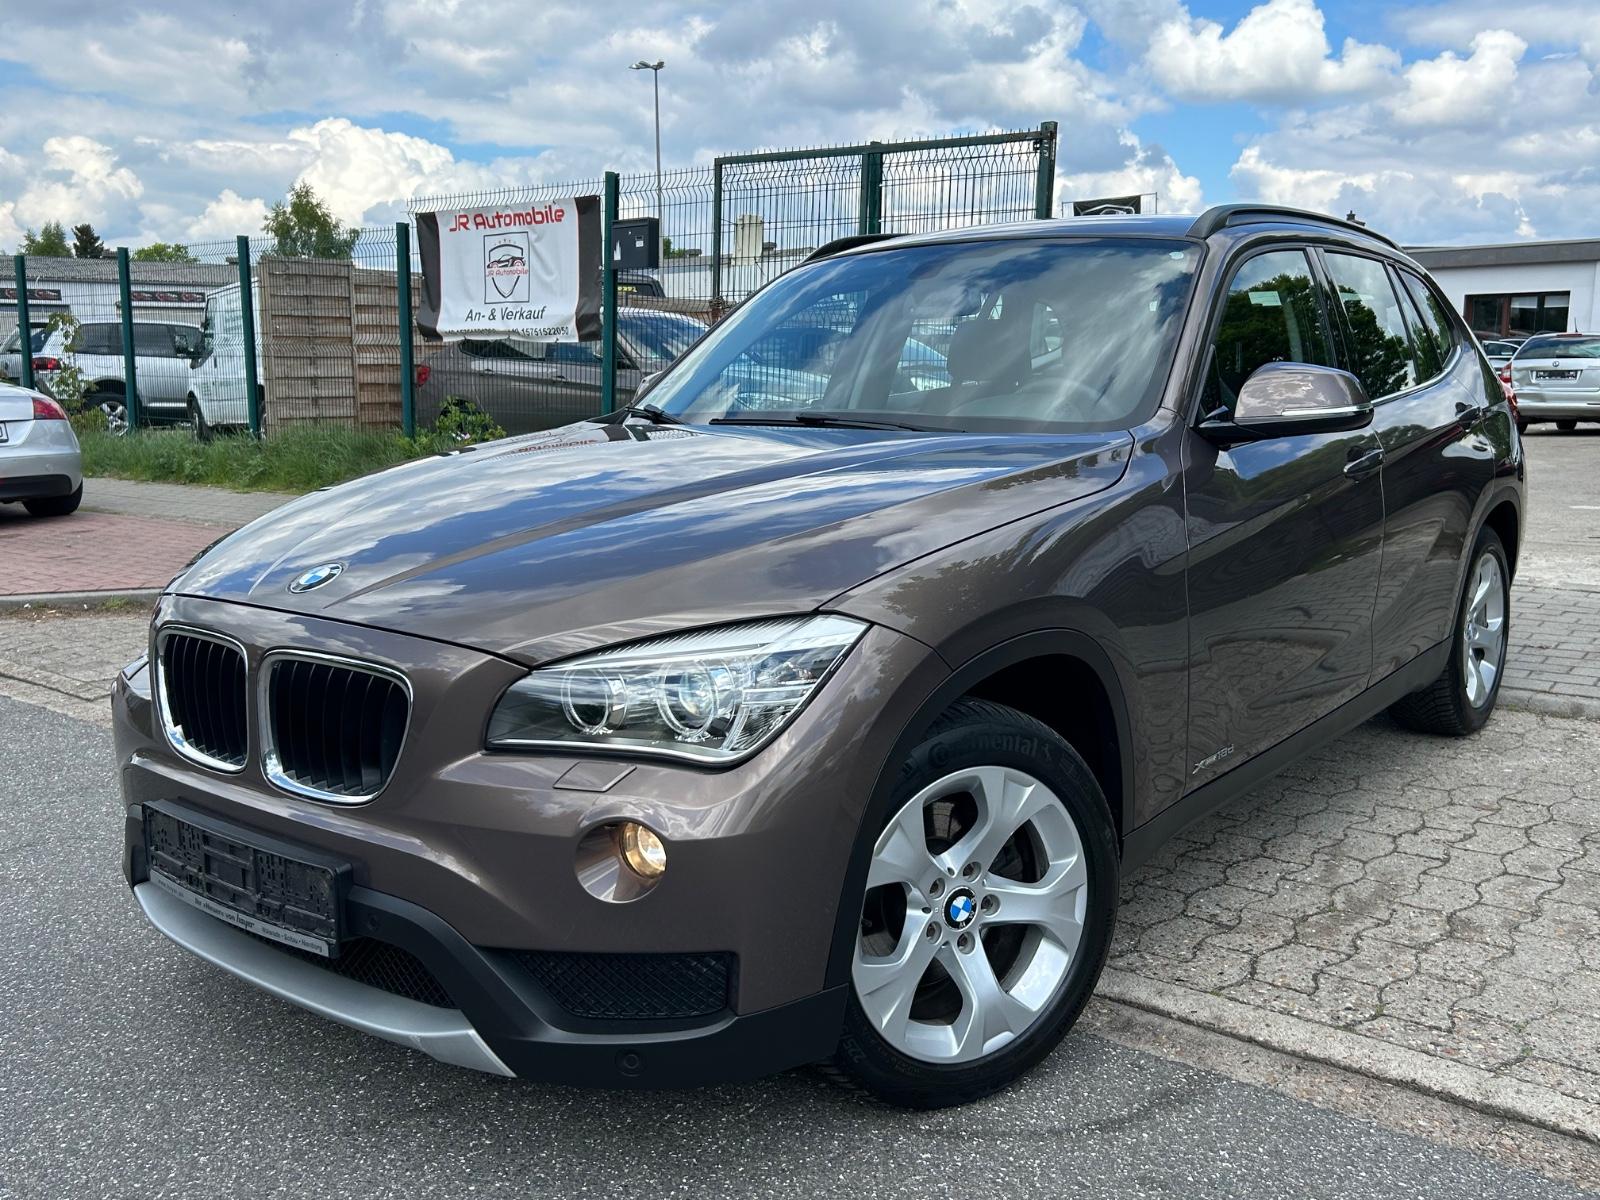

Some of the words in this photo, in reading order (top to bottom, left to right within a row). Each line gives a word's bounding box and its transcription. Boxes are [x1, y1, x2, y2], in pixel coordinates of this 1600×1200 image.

[450, 214, 470, 232] JR
[474, 204, 566, 230] Automobile
[487, 269, 495, 277] JR
[495, 267, 529, 276] Automobile
[465, 308, 486, 322] An-
[488, 307, 497, 321] &
[500, 305, 547, 321] Verkauf
